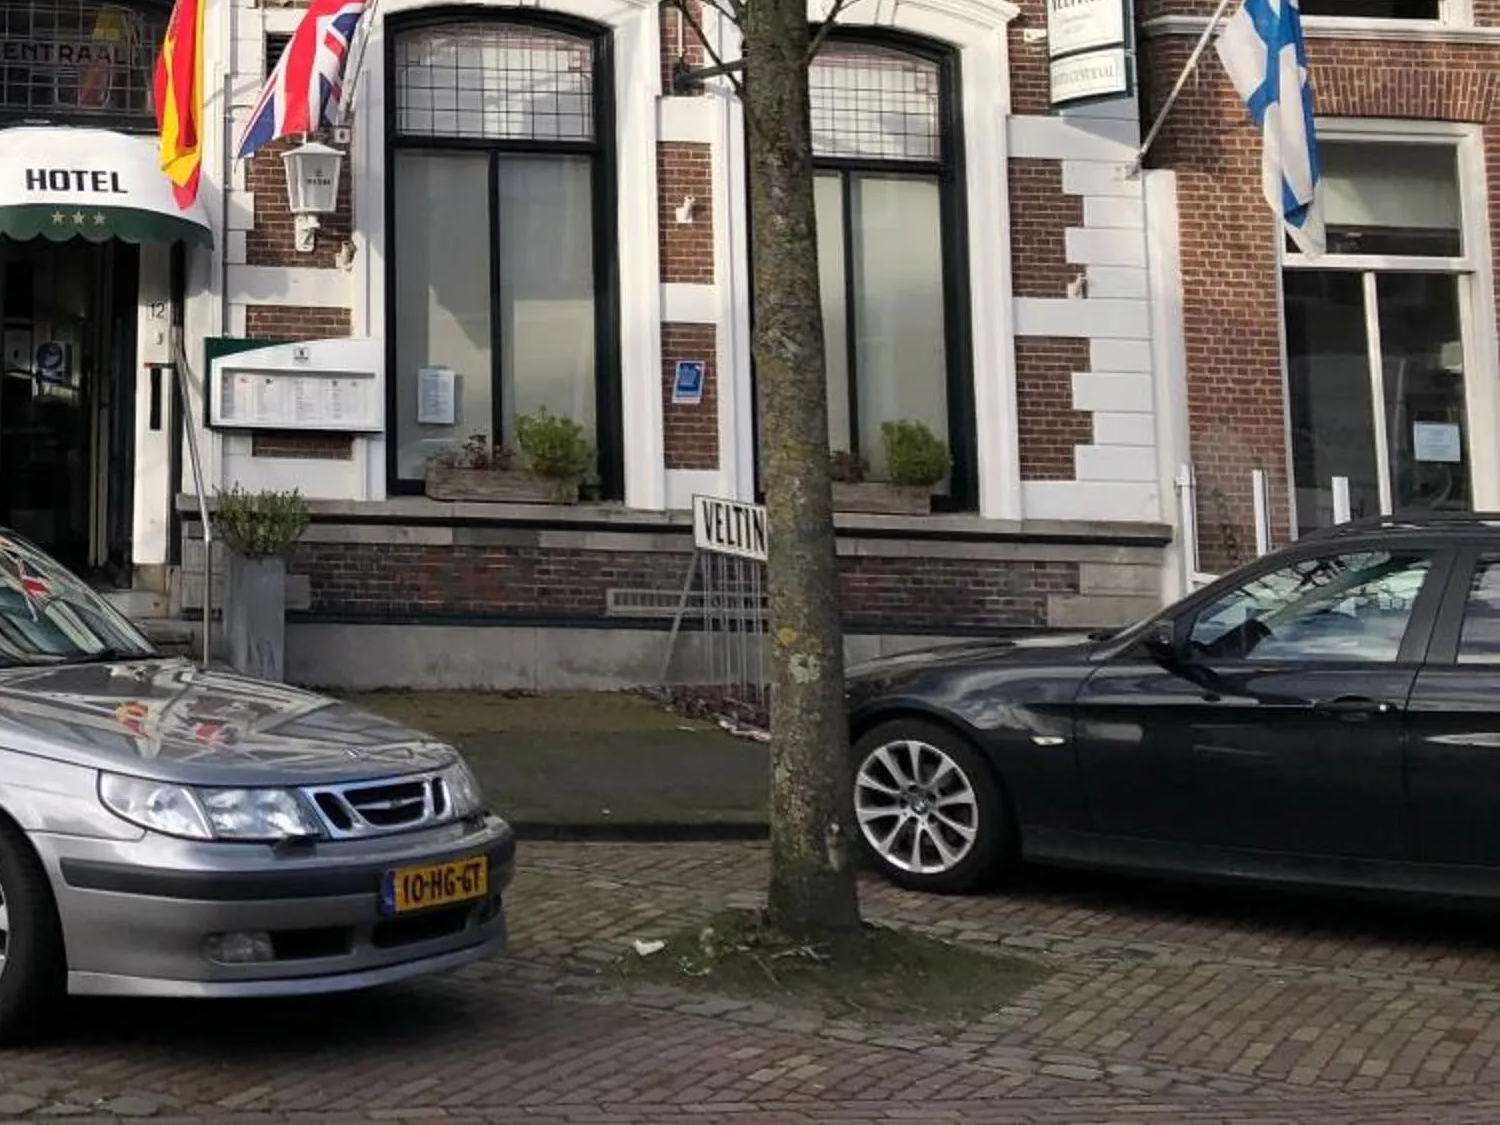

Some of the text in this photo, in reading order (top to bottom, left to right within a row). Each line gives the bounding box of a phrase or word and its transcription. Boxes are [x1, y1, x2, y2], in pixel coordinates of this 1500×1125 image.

[25, 168, 129, 195] HOTEL
[149, 301, 165, 320] 12
[702, 500, 766, 552] VELTIN
[402, 862, 482, 907] 10-HG-GT
